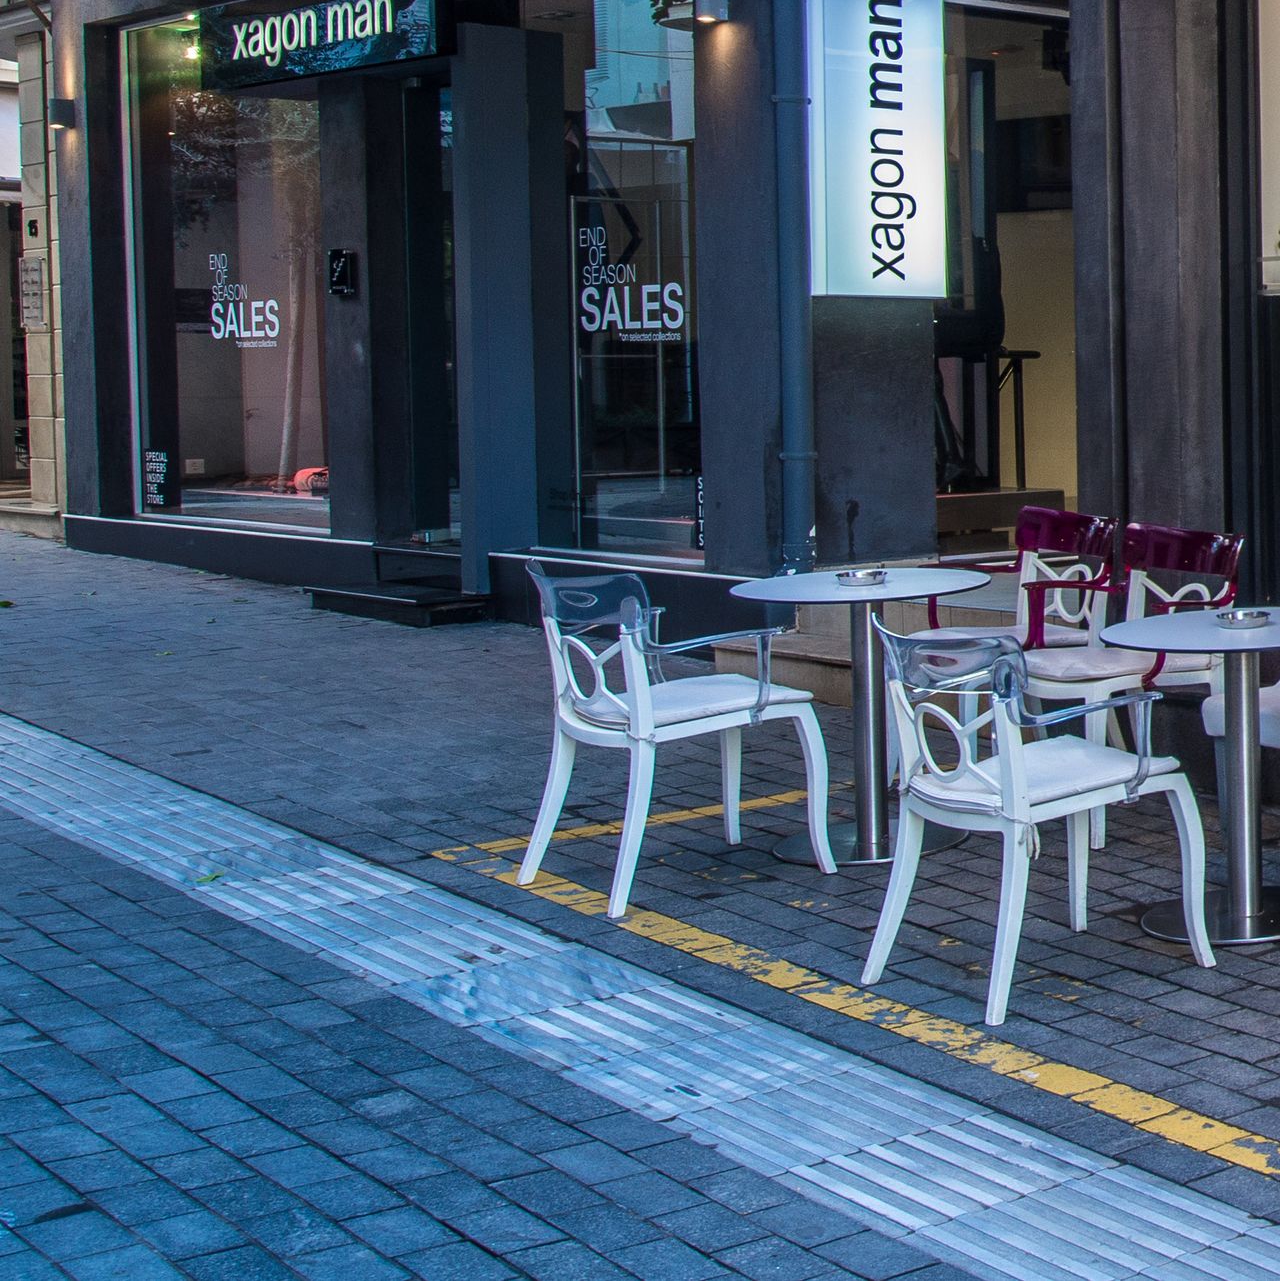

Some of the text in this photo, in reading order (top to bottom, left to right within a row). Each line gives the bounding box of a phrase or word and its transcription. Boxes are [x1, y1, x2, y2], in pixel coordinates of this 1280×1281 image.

[232, 9, 317, 67] xagon
[870, 128, 917, 281] xagon
[579, 226, 606, 247] END
[209, 253, 227, 270] END
[589, 246, 606, 265] OF
[216, 269, 228, 285] OF
[583, 264, 636, 285] SEASON
[212, 284, 248, 301] SEASON
[581, 283, 684, 331] SALES
[211, 299, 279, 339] SALES
[146, 452, 168, 462] SPECIAL
[146, 462, 167, 473] OFFERS
[146, 473, 164, 483] INSIDE
[147, 483, 158, 493] THE
[147, 494, 164, 505] STORE
